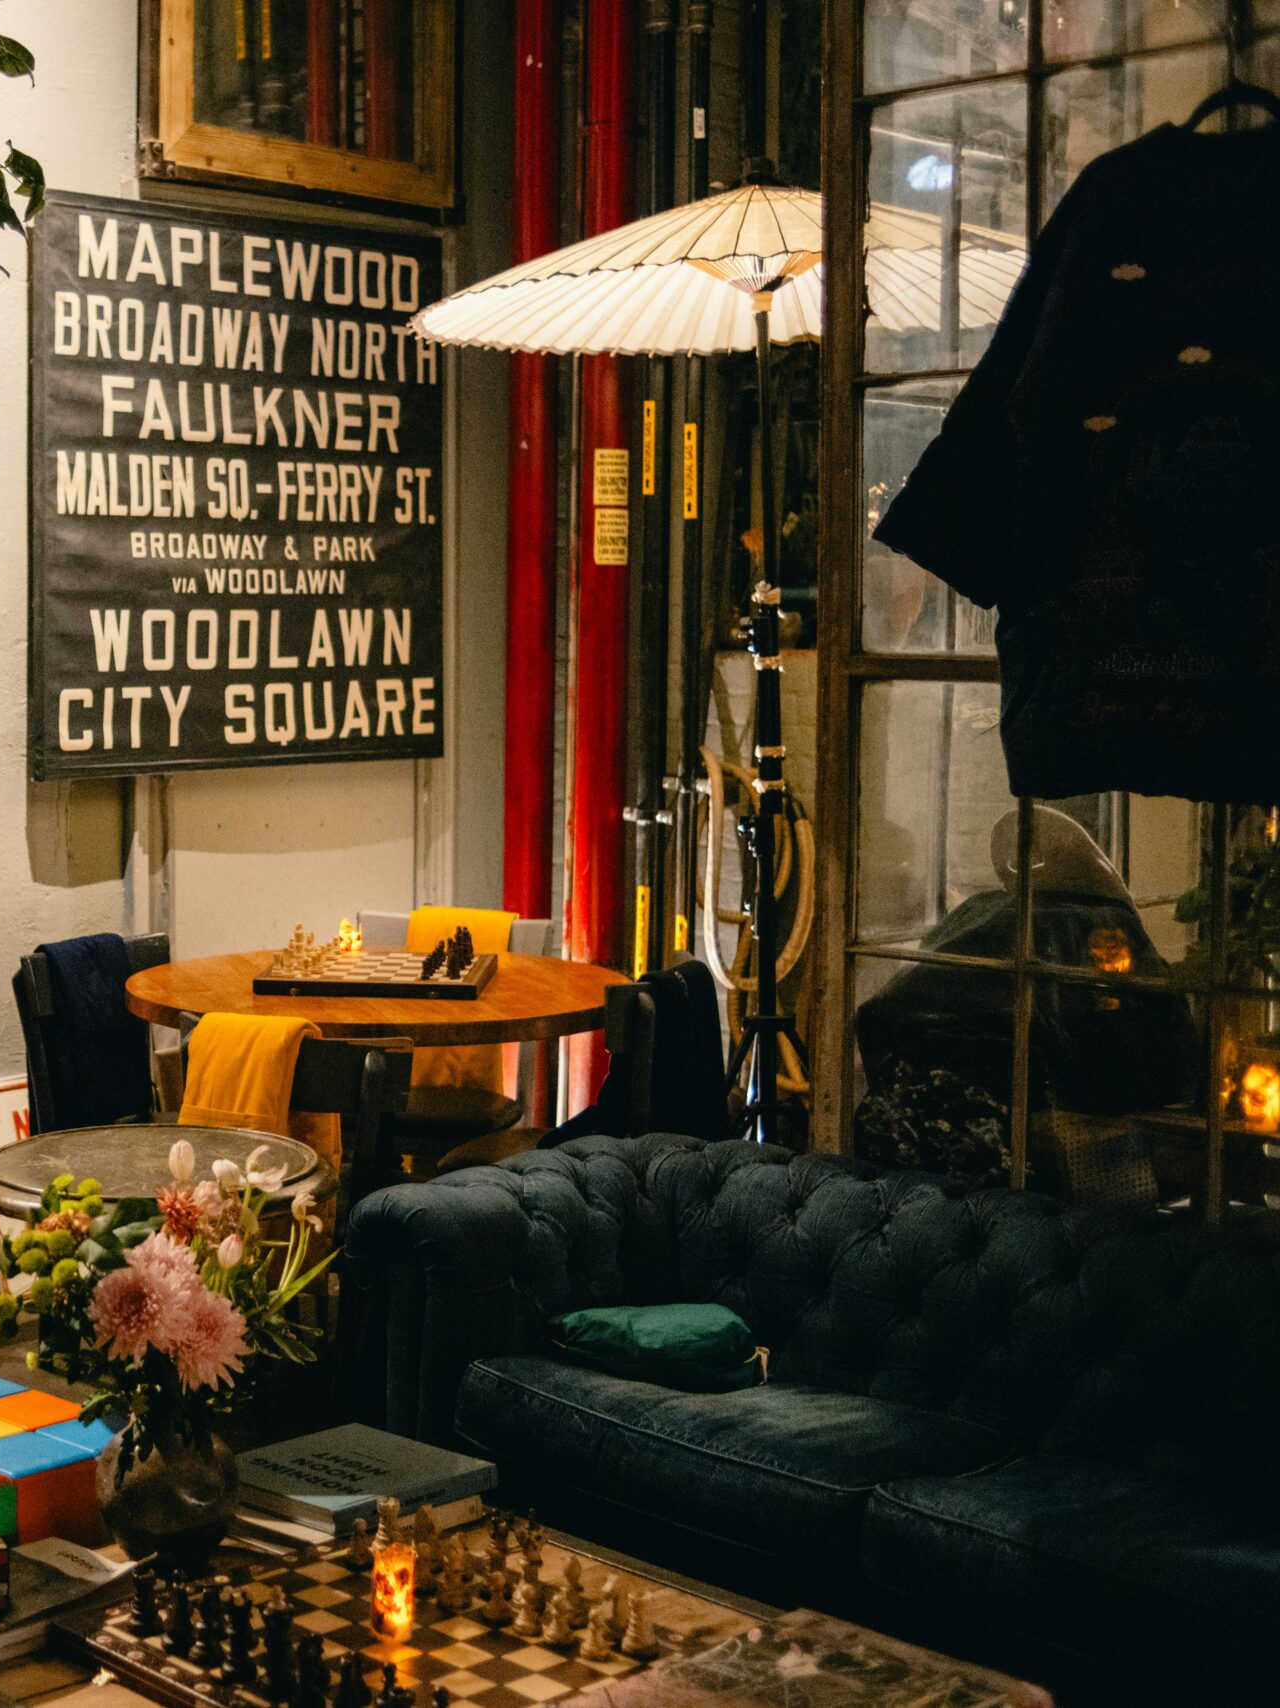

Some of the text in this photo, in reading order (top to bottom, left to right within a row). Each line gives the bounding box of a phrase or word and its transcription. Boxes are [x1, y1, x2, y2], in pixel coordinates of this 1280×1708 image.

[77, 214, 420, 313] MAPLEWOOD
[53, 291, 438, 386] BROADWAY NORTH
[101, 374, 401, 454] FAULKNER
[55, 450, 196, 518] MALDEN
[395, 466, 436, 526] ST.
[130, 531, 377, 563] BROADWAY & PARK
[172, 569, 346, 595] VIA WOODLAWN
[88, 607, 411, 674] WOODLAWN
[58, 676, 436, 752] CITY SQUARE
[291, 1457, 365, 1482] NOON
